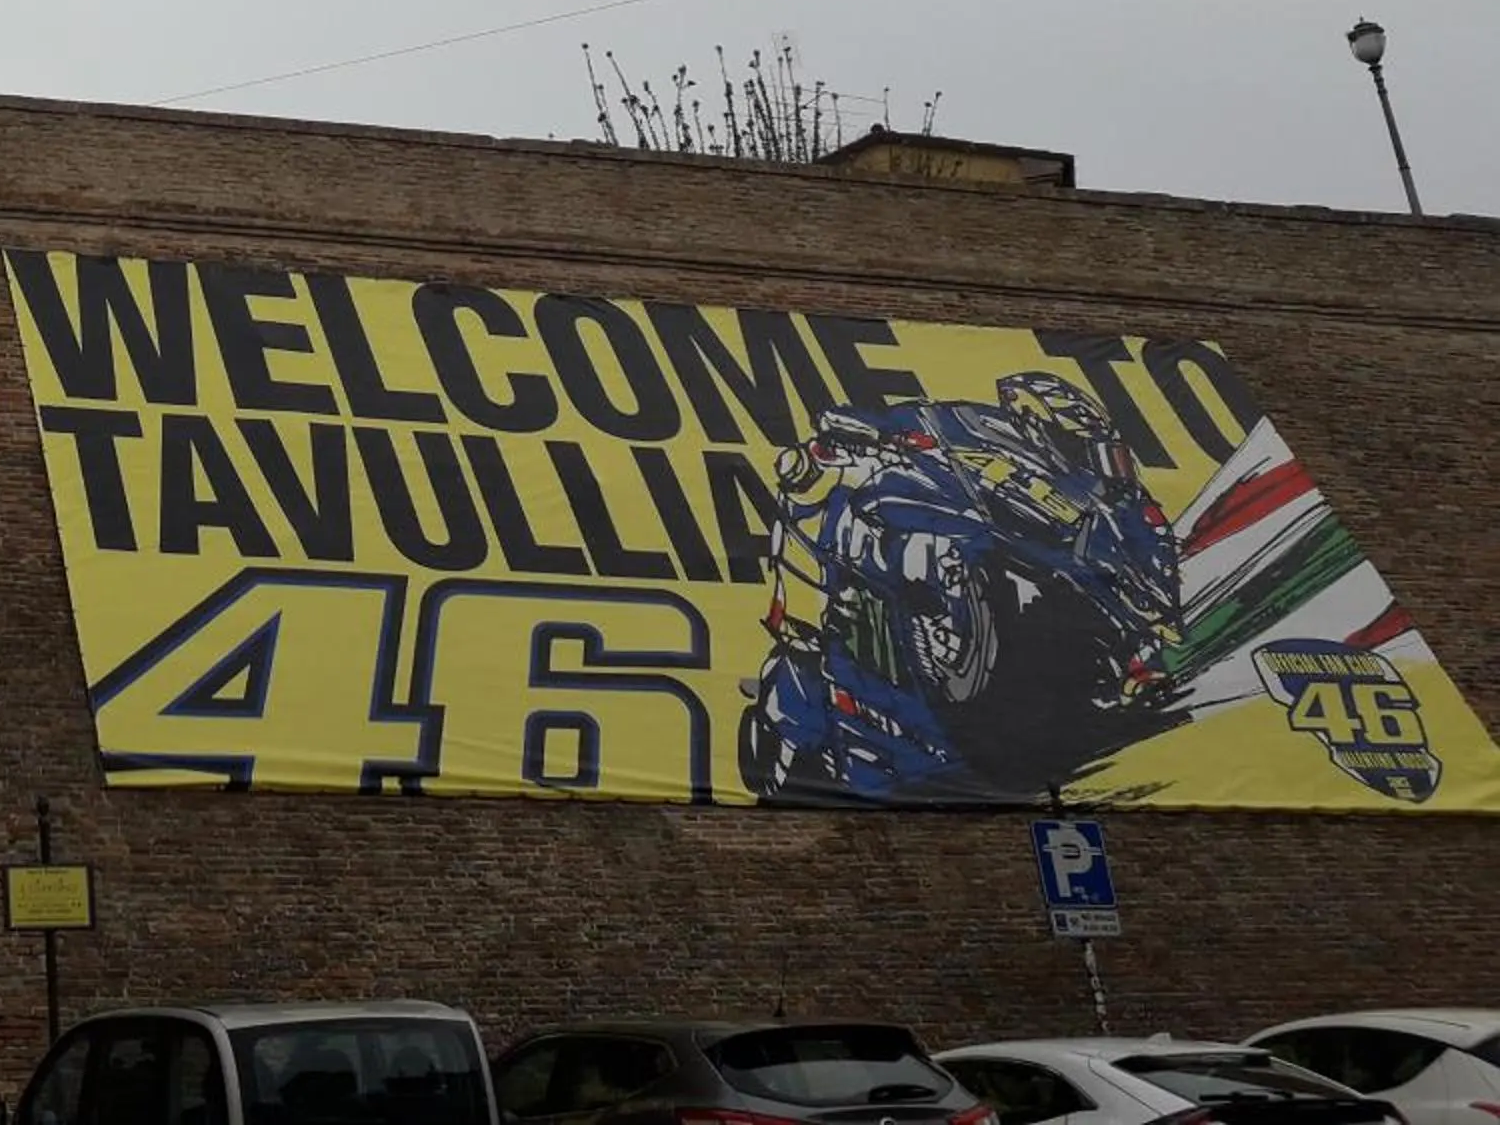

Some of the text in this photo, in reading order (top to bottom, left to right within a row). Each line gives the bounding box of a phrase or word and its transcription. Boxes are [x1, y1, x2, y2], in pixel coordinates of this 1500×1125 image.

[4, 249, 1267, 470] WELCOME TO
[41, 405, 785, 584] TAVULLIA
[88, 567, 711, 805] 46
[1291, 681, 1425, 745] 46
[1046, 828, 1094, 898] P
